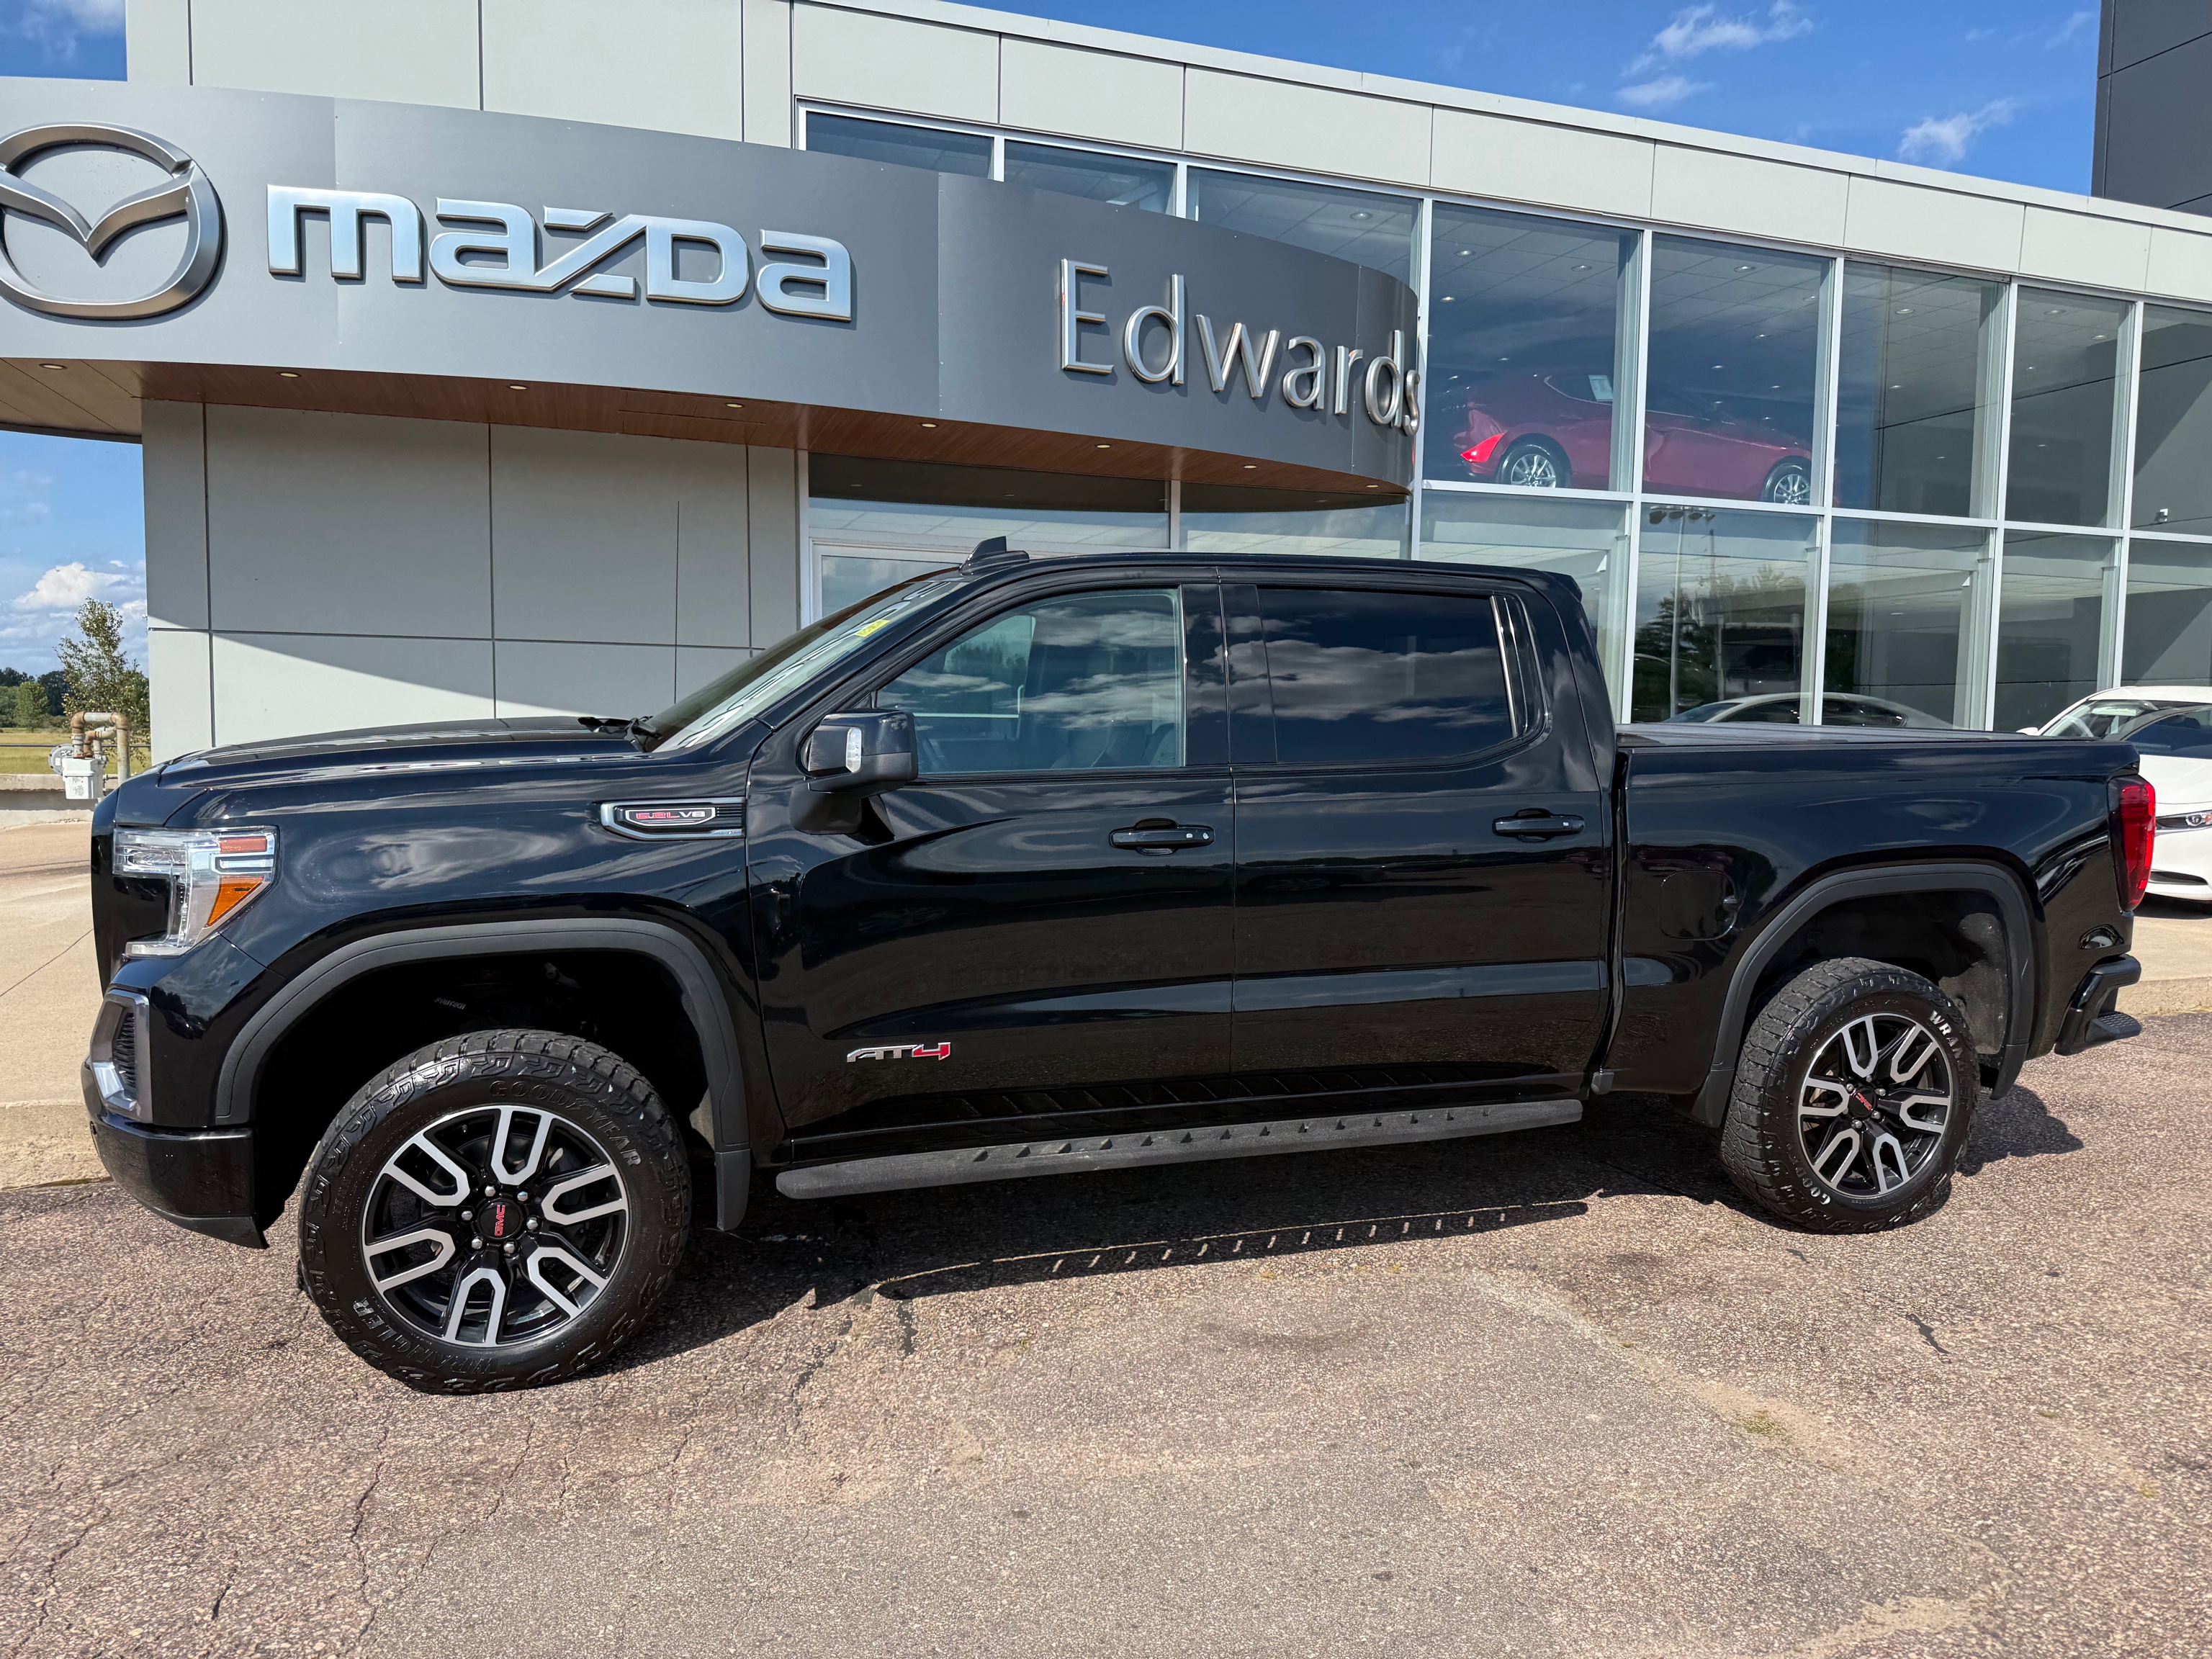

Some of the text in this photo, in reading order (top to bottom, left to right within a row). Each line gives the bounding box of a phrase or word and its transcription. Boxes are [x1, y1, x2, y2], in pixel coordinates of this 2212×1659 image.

[1061, 258, 1420, 436] Edwards
[847, 1041, 951, 1063] AT4
[494, 1204, 506, 1236] GMC
